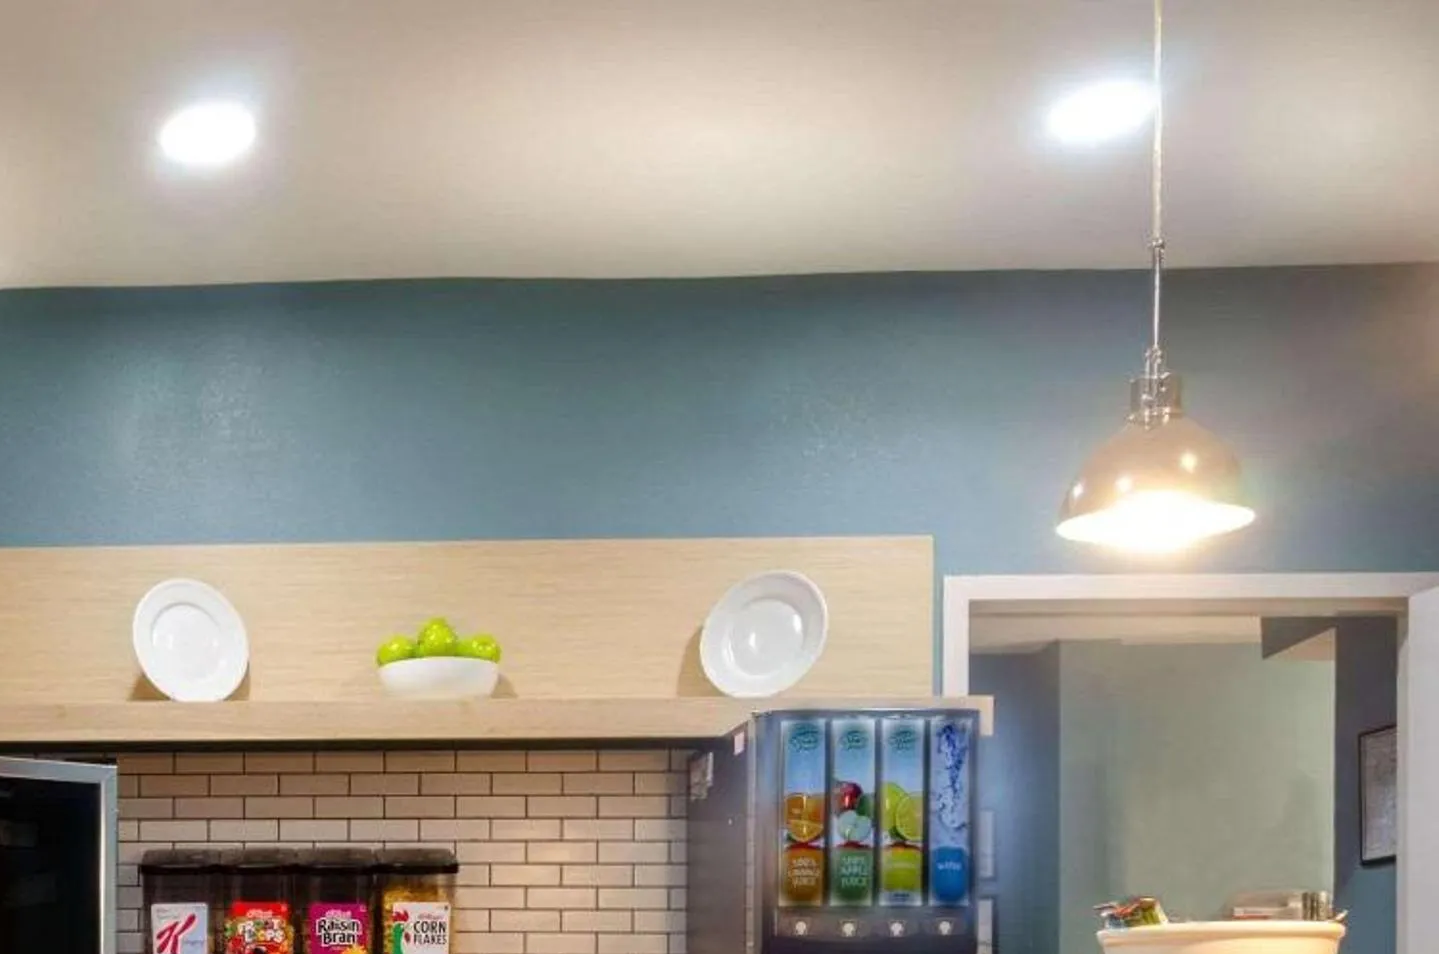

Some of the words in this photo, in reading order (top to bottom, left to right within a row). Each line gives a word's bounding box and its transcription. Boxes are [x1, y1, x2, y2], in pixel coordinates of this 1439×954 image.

[317, 919, 361, 933] Raisin
[413, 920, 447, 934] CORN
[323, 932, 356, 944] Bran
[413, 932, 447, 945] FLAKES
